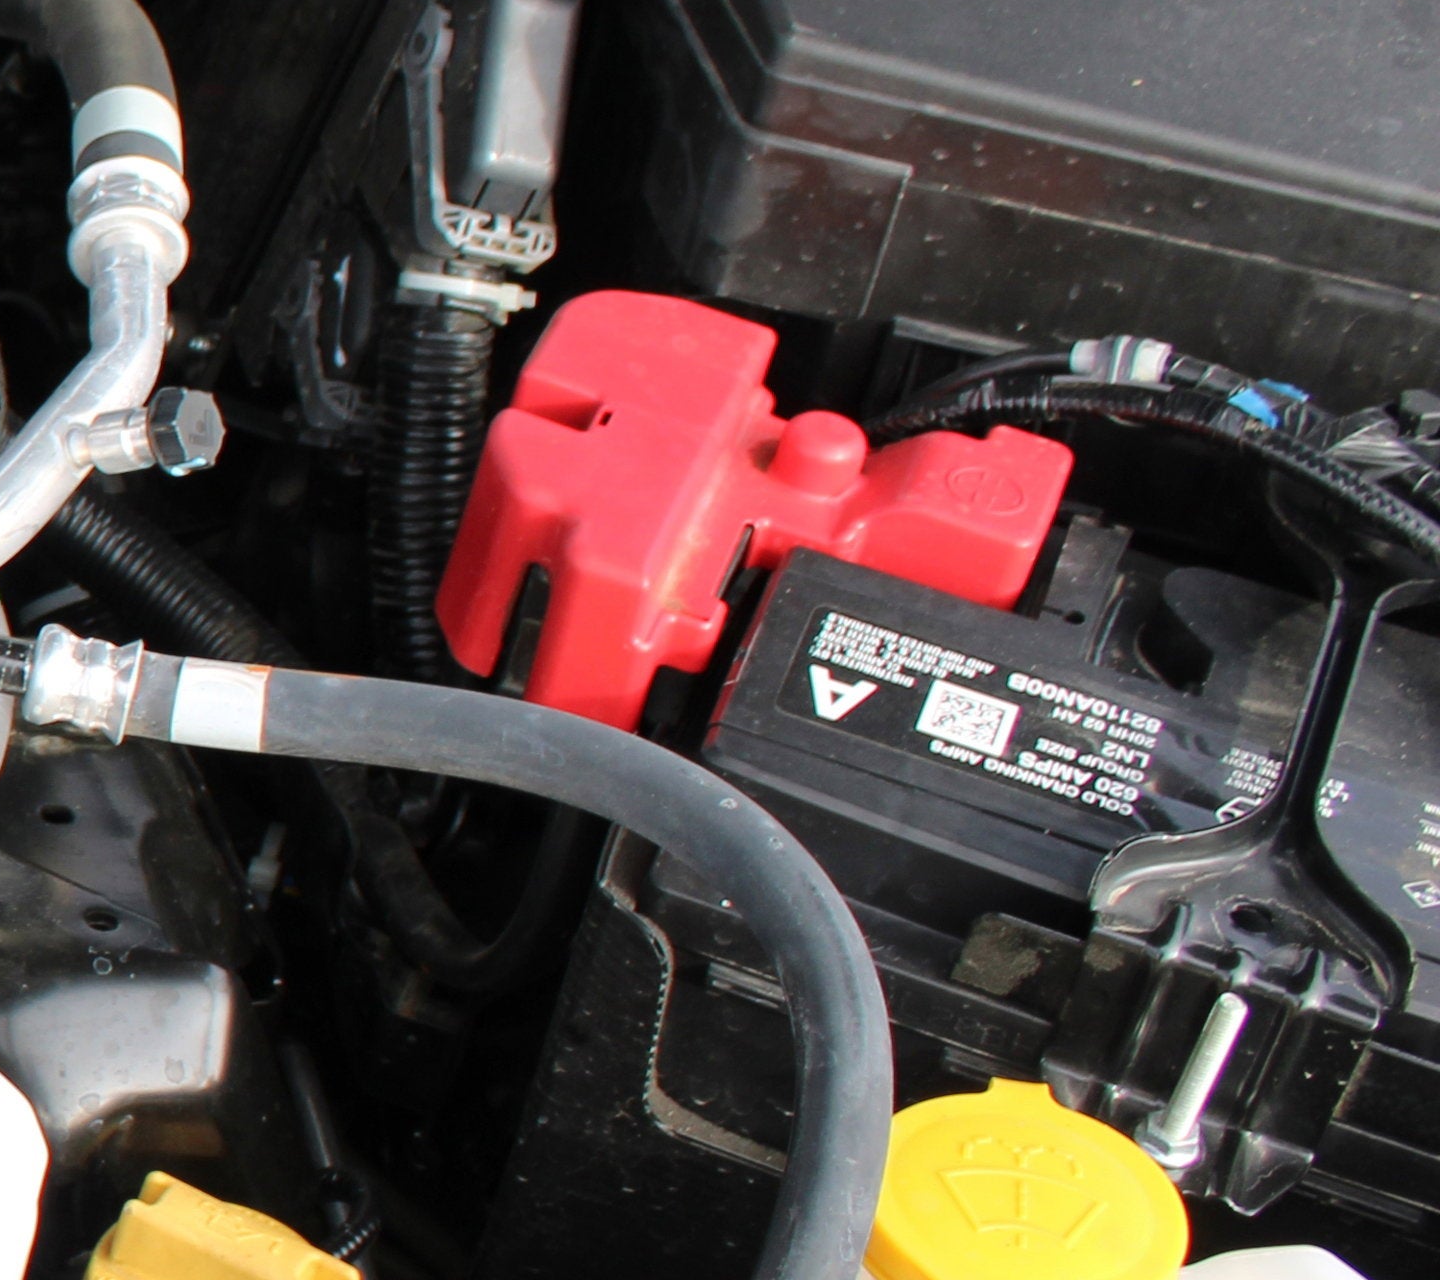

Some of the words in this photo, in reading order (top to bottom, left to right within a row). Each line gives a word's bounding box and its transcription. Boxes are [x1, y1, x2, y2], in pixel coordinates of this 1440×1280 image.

[826, 612, 899, 641] MATERIALS
[898, 637, 965, 663] IMPORTED
[833, 657, 915, 687] DISTRIBUTED
[965, 658, 995, 673] AND
[1007, 672, 1164, 734] 82110AN00B
[1052, 706, 1082, 725] AH
[1082, 716, 1107, 733] 62
[1107, 723, 1158, 749] 20HR
[929, 739, 983, 766] AMPS
[1035, 737, 1079, 762] SIZE
[1100, 740, 1152, 769] LN2
[982, 757, 1081, 799] CRANKING
[1018, 751, 1093, 786] AMPS
[1078, 754, 1147, 784] GROUP
[1081, 790, 1136, 816] COLD
[1094, 776, 1141, 803] 620
